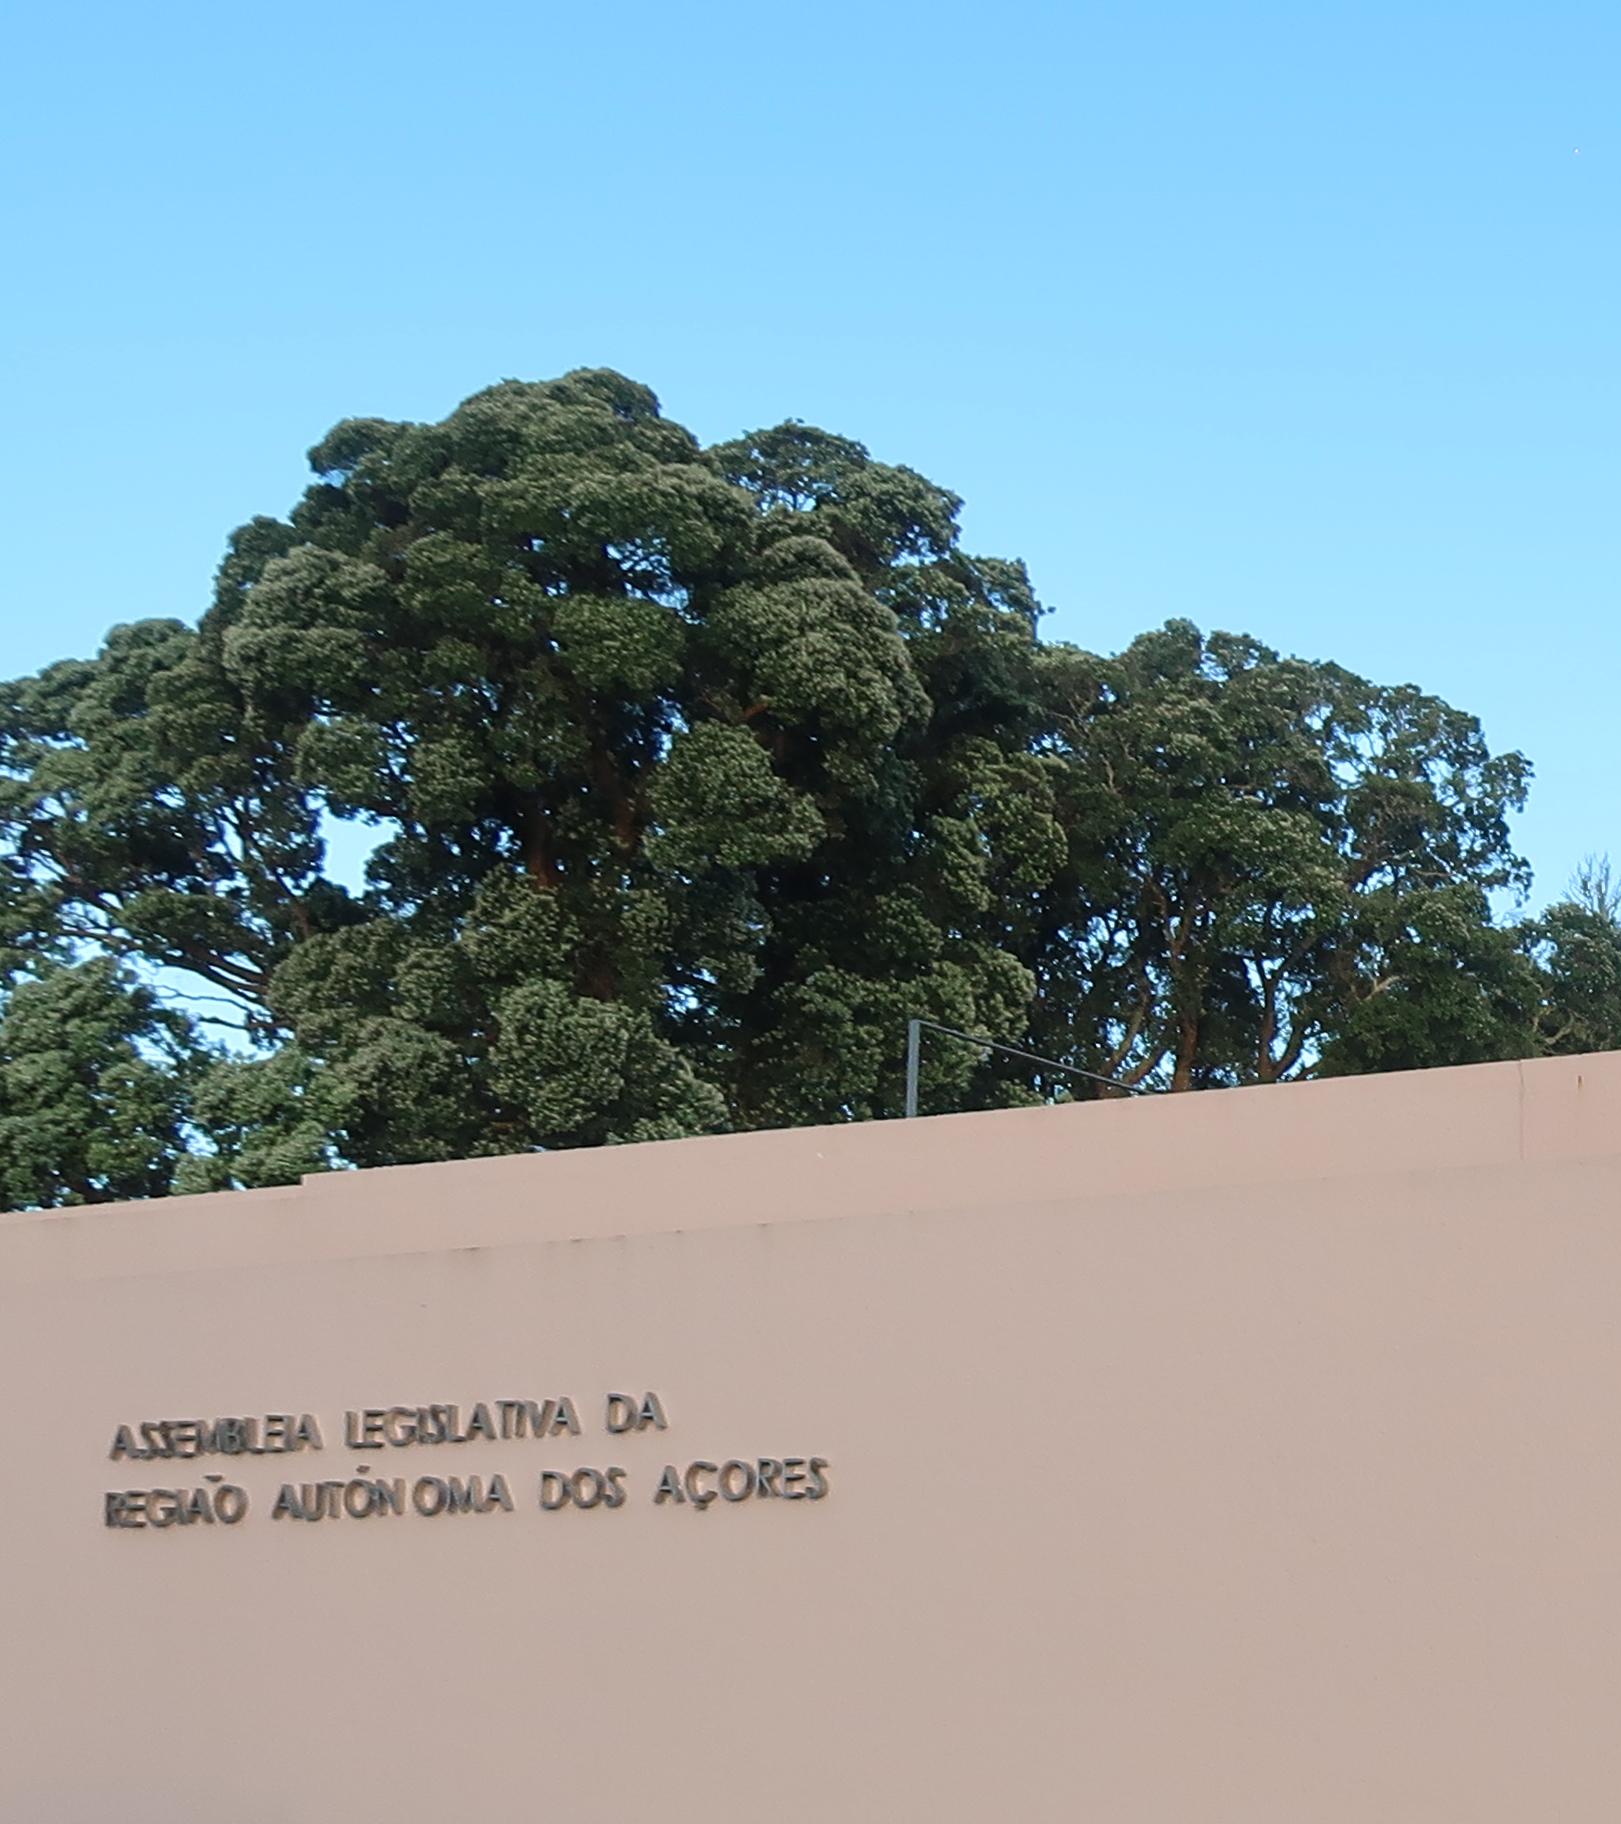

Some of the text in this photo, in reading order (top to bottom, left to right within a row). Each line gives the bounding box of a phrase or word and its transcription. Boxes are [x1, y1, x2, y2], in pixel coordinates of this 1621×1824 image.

[108, 1391, 668, 1461] ASSEMBLEIA LEGISLATIVA DA
[104, 1473, 250, 1529] REGIÃO
[540, 1465, 627, 1511] DOS
[653, 1456, 829, 1511] AÇORES
